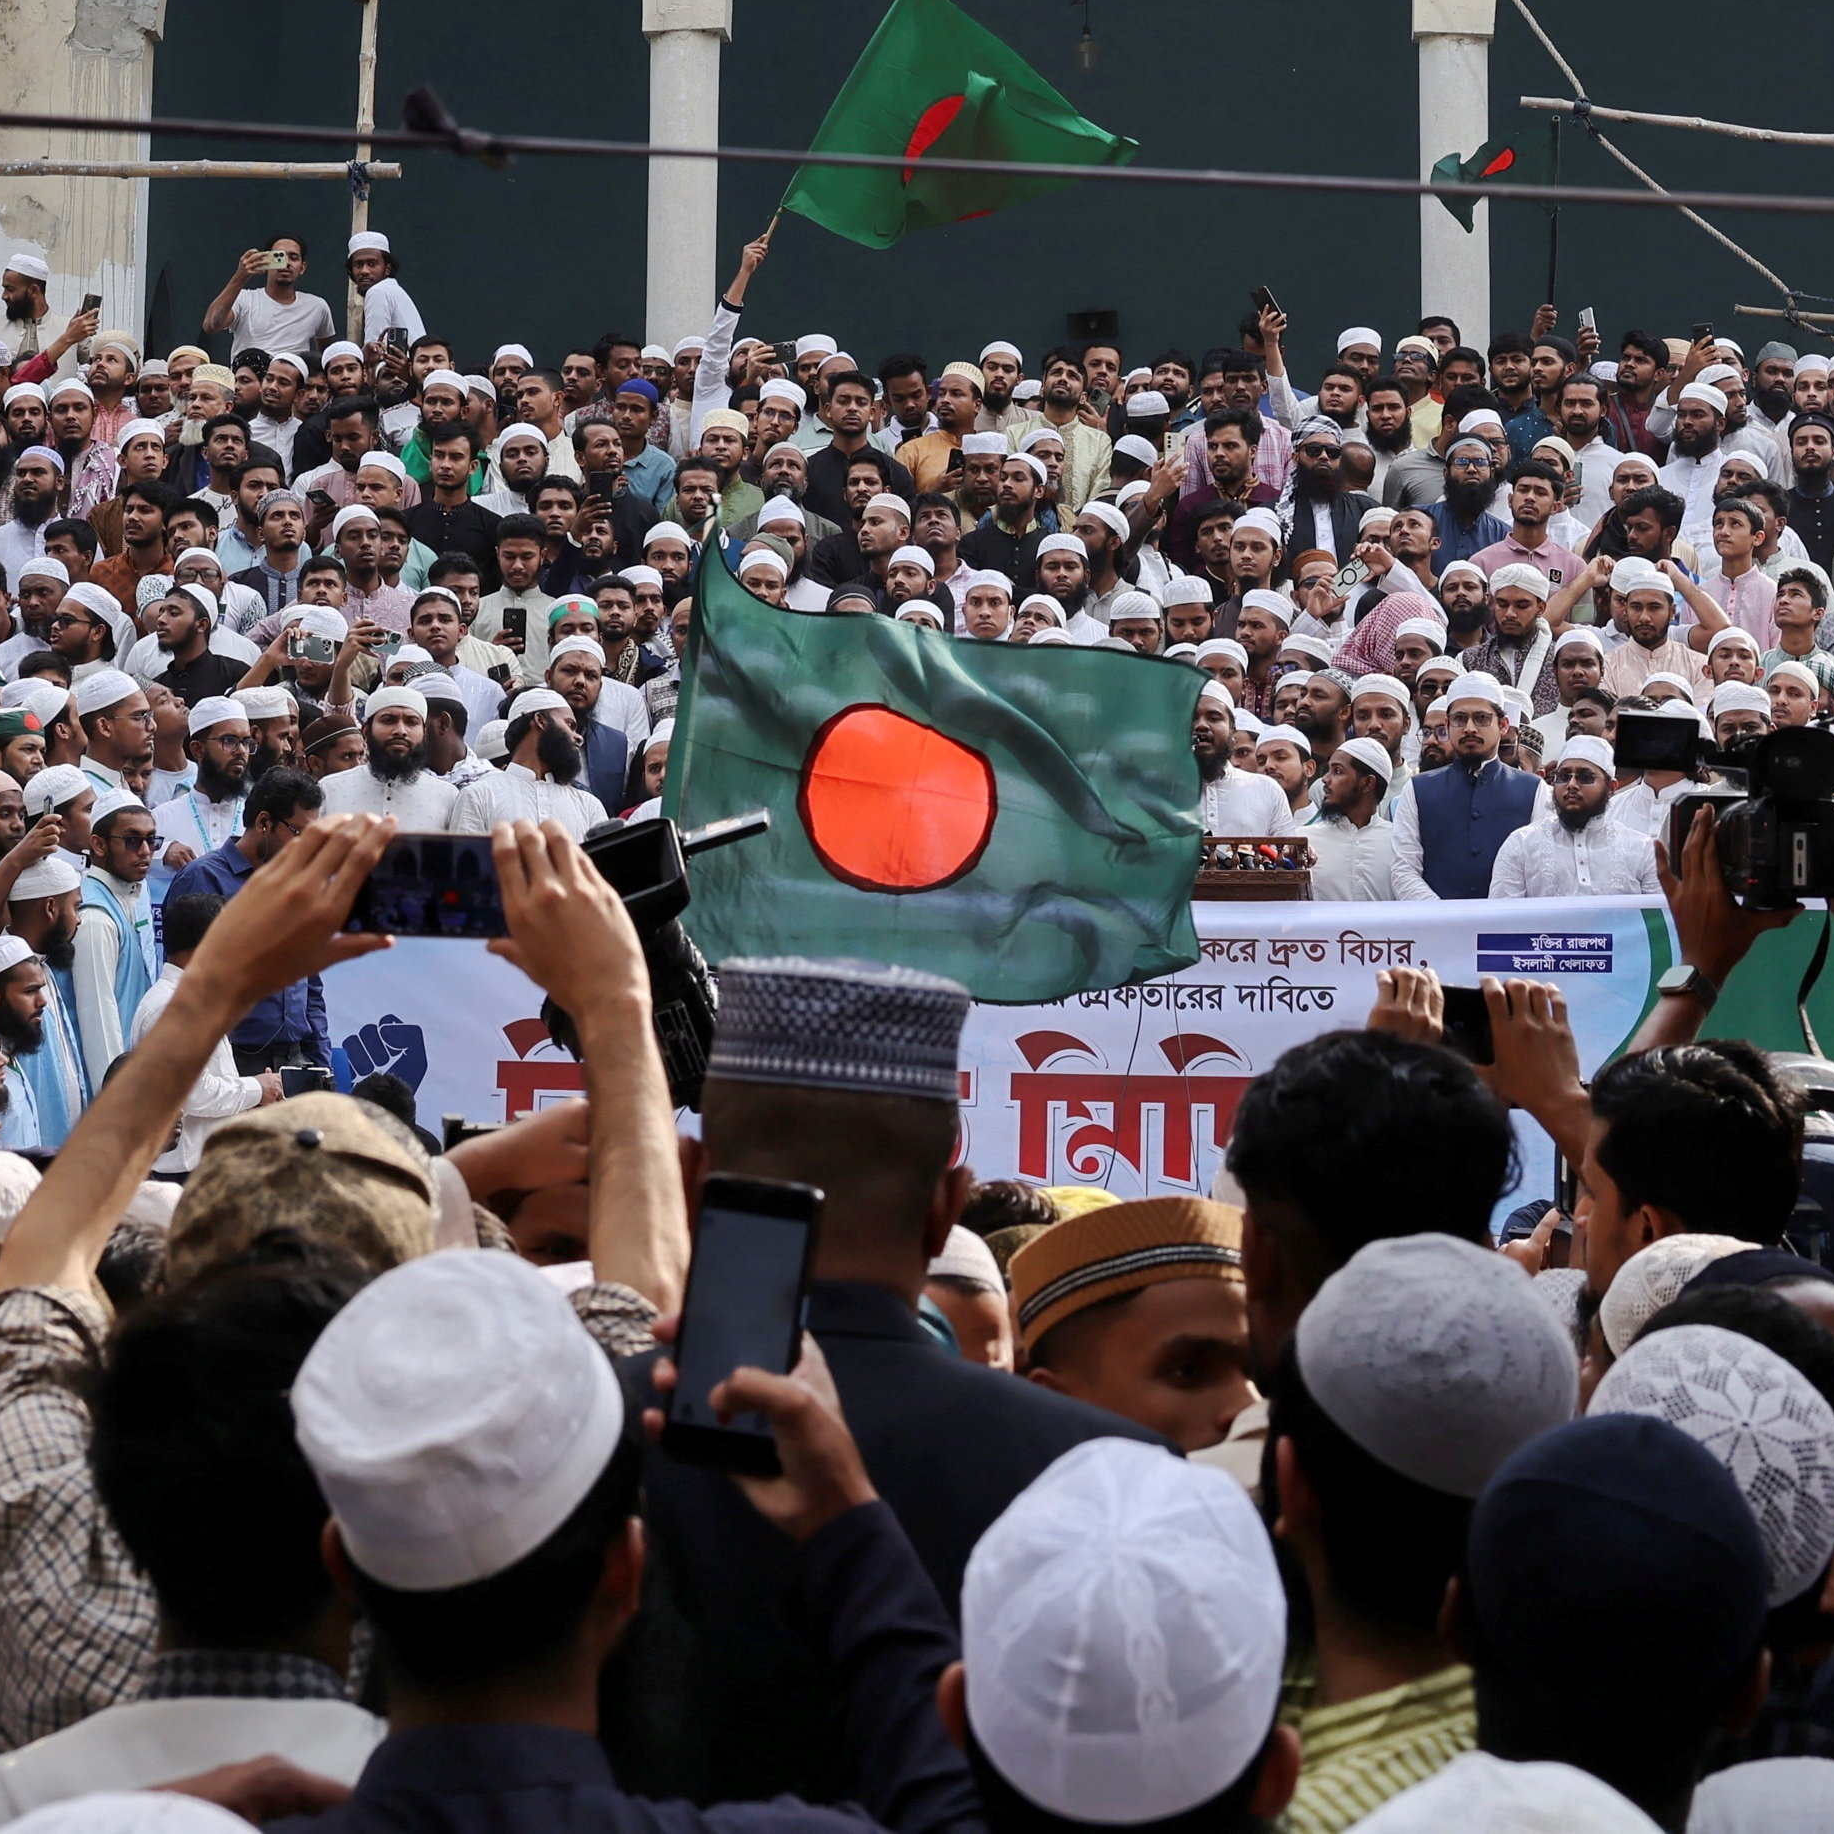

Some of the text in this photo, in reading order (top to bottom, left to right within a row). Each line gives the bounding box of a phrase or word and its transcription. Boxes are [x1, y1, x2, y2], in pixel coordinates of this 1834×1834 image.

[1267, 937, 1329, 969] দ্রুত
[1530, 934, 1608, 952] মুক্তির রাজপথ
[1512, 954, 1608, 972] ইসলামী খেলাফত
[1234, 975, 1338, 1015] দাবিতে
